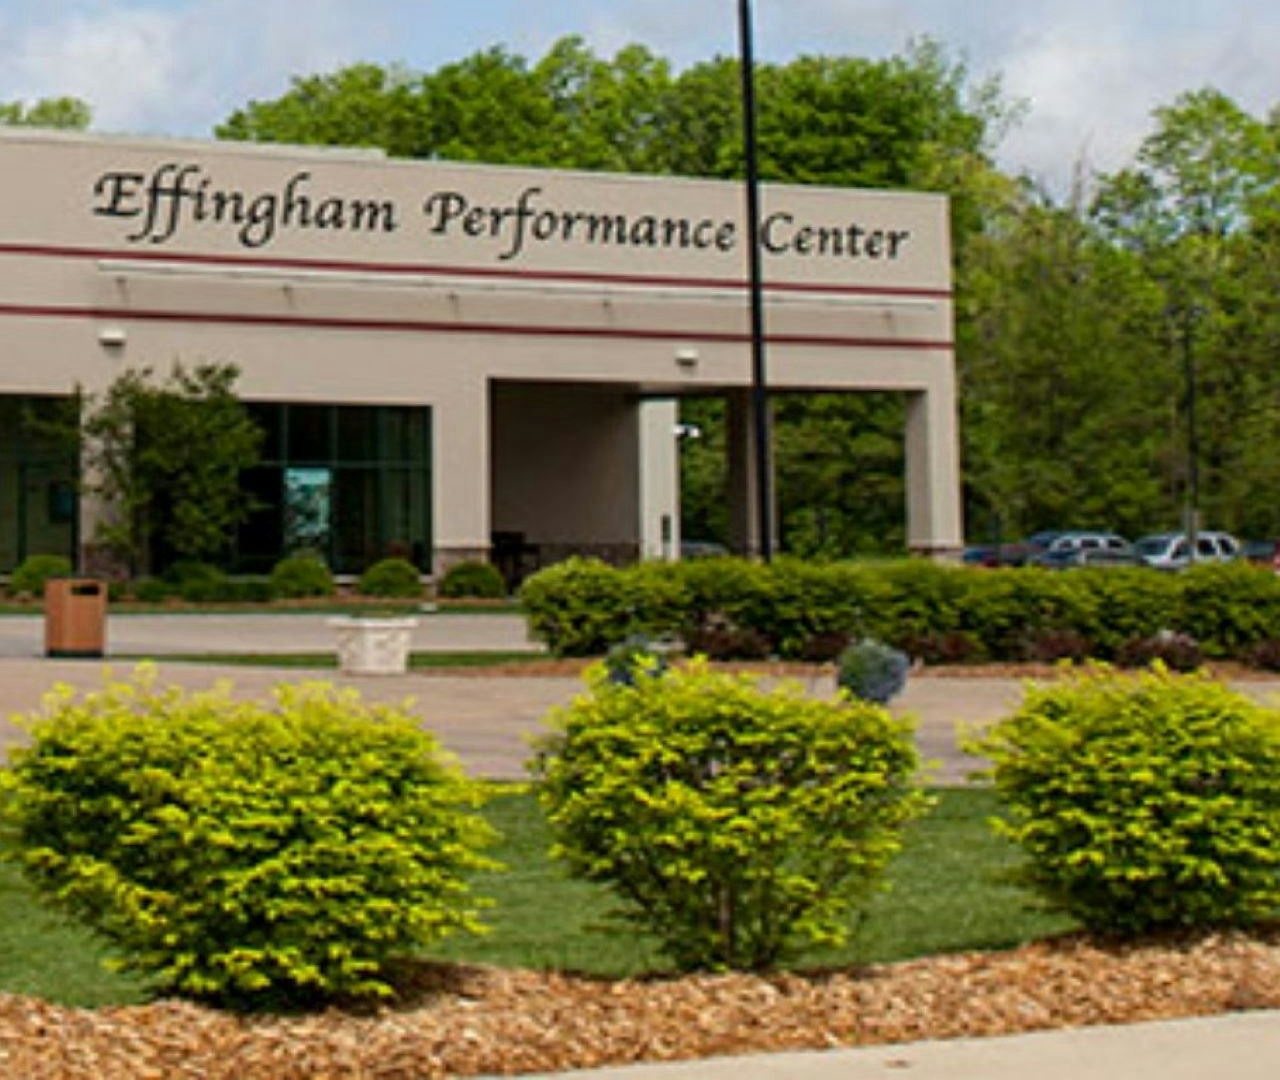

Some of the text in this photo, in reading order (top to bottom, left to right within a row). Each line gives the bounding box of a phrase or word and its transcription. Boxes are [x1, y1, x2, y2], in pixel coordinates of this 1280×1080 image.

[93, 164, 909, 261] Effingham Performance Center
